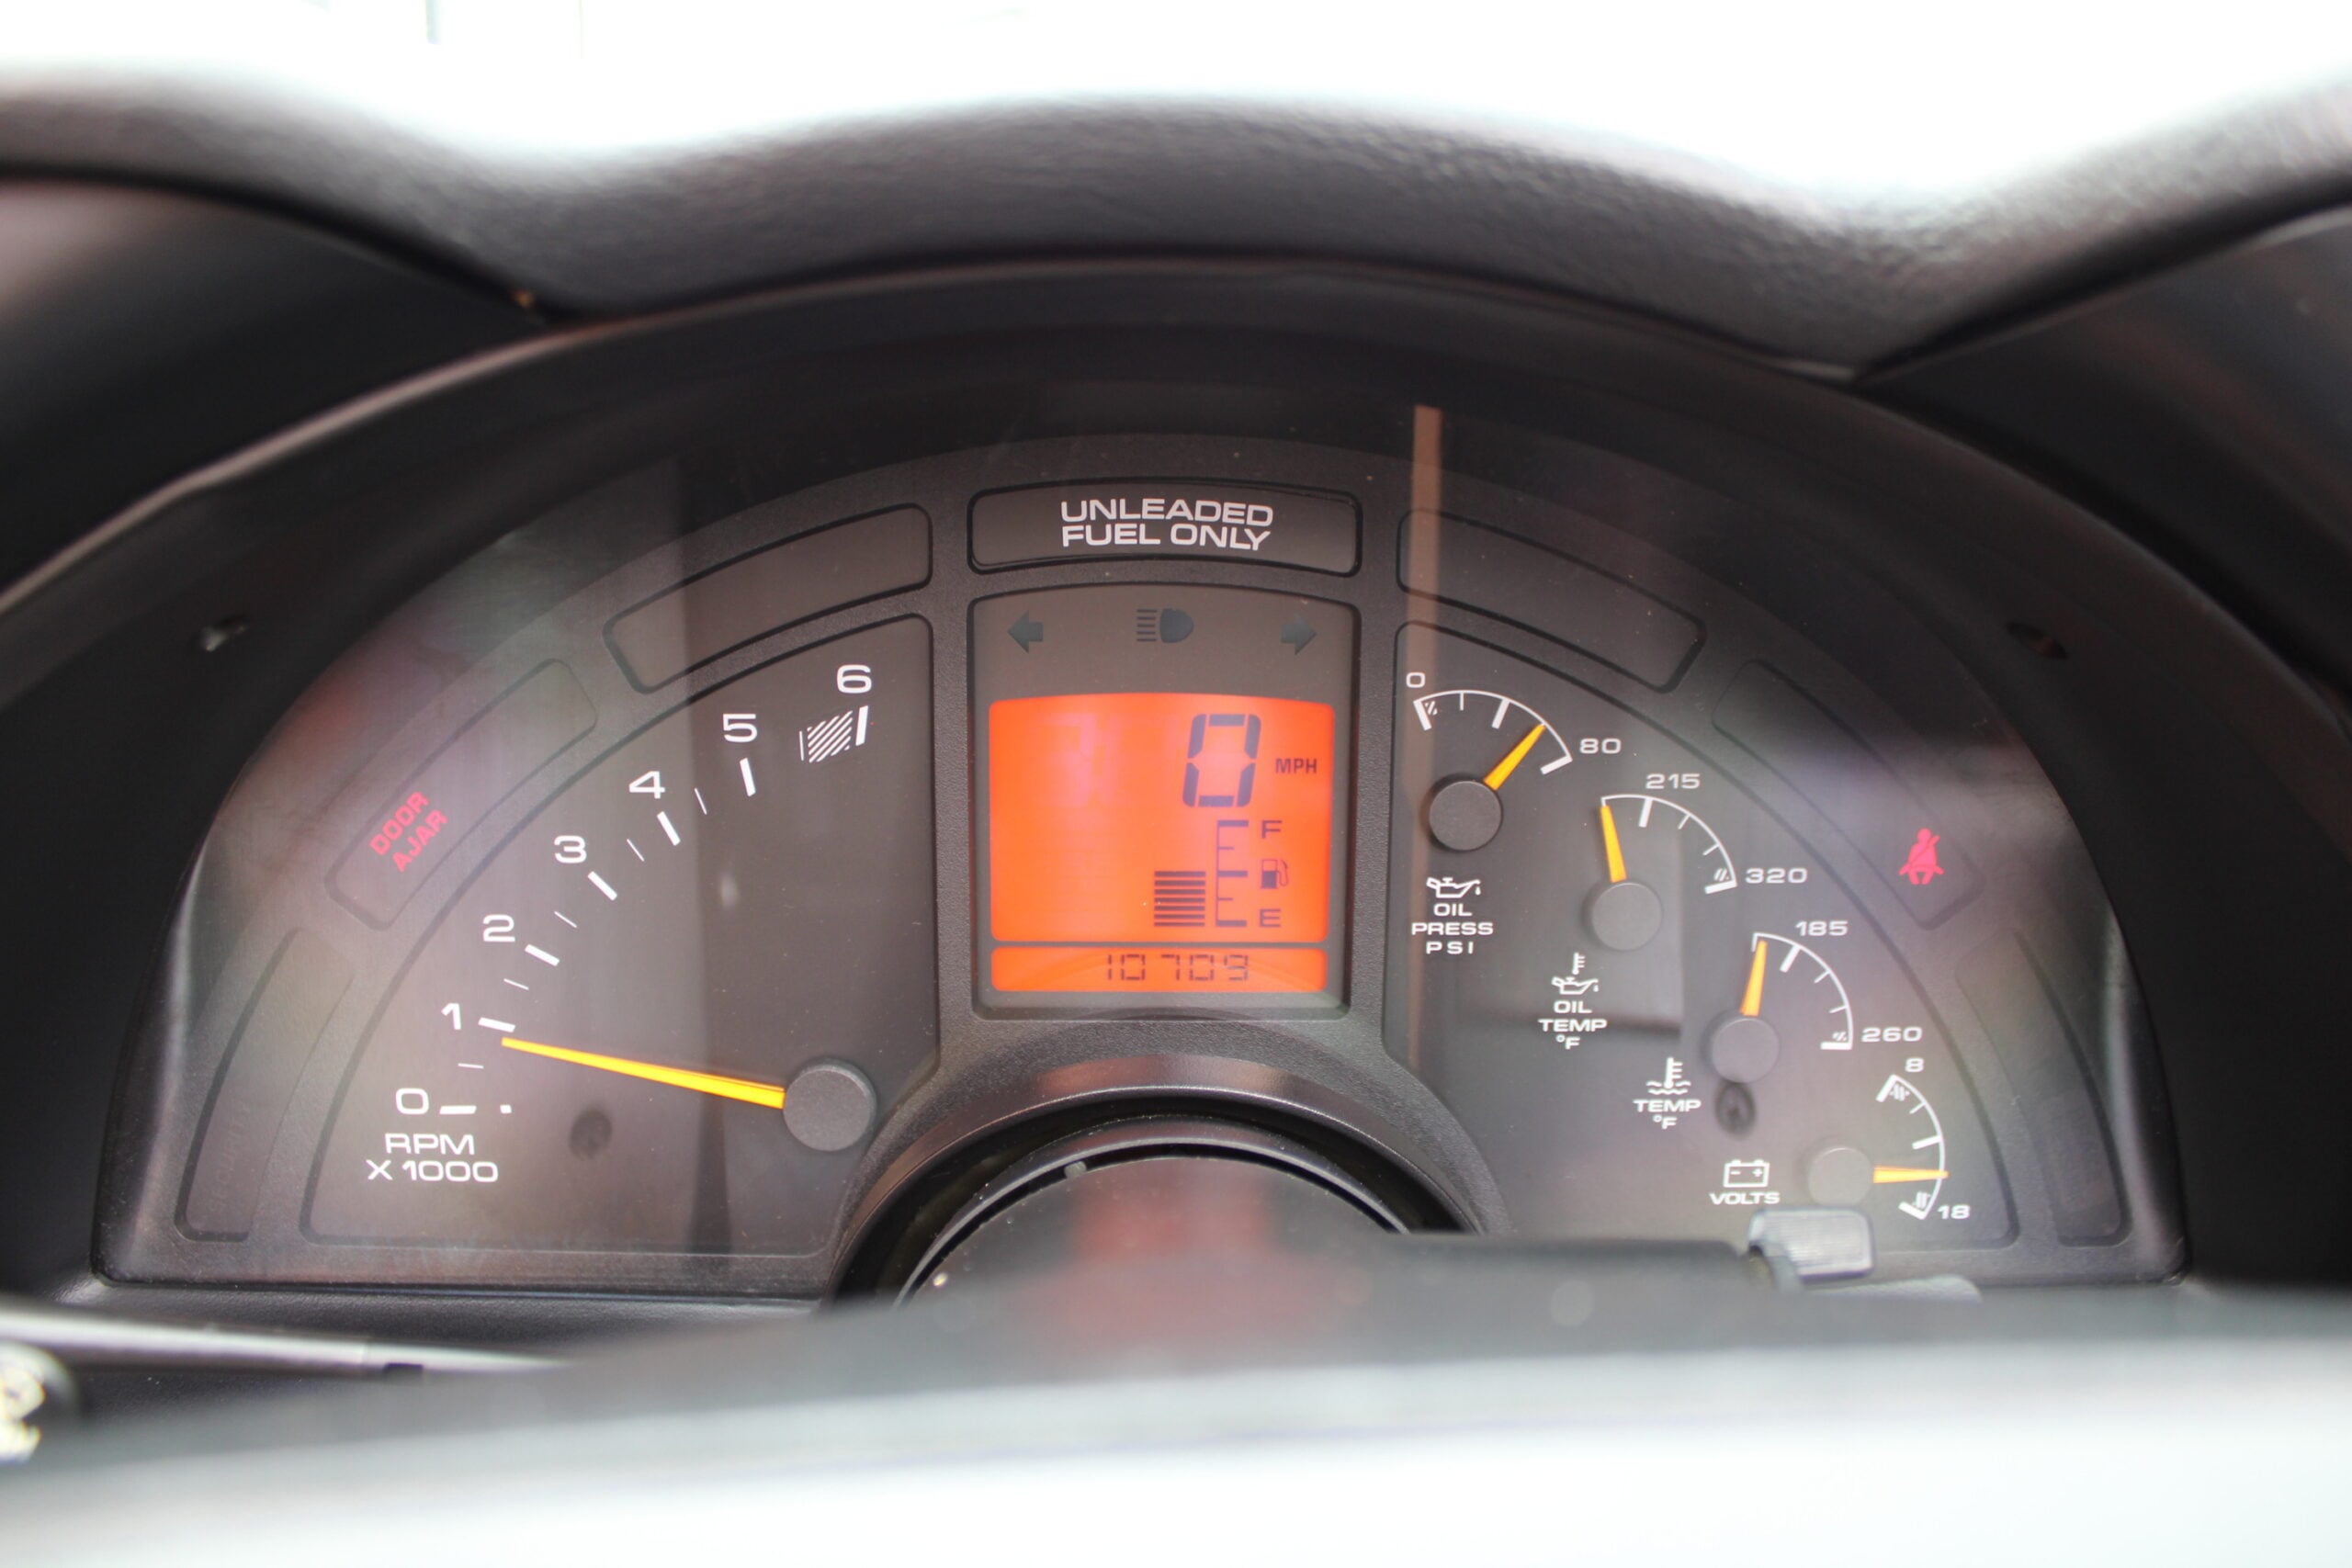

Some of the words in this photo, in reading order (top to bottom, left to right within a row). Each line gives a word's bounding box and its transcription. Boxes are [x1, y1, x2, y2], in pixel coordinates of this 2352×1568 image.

[1061, 498, 1273, 528] UNLEADED
[1062, 523, 1160, 547] FUEL
[1170, 523, 1272, 551] ONLY
[837, 665, 872, 694] 6
[1406, 672, 1427, 689] 0
[722, 714, 757, 742] 5
[1580, 738, 1622, 755] 80
[1182, 714, 1261, 807] 0
[1275, 758, 1317, 774] MPH
[629, 771, 664, 798] 4
[1645, 773, 1701, 790] 215
[369, 791, 429, 856] DOOR
[1261, 820, 1283, 840] F
[391, 808, 447, 872] AJAR
[554, 836, 586, 863] 3
[1746, 868, 1807, 884] 320
[1259, 908, 1282, 928] E
[1434, 903, 1472, 917] OIL
[482, 915, 514, 942] 2
[1411, 922, 1494, 936] PRESS
[1796, 921, 1849, 937] 185
[1107, 953, 1249, 981] 10709
[442, 1003, 461, 1029] 1
[1553, 1000, 1592, 1014] OIL
[1539, 1019, 1607, 1033] TEMP
[1861, 1027, 1923, 1043] 260
[1905, 1058, 1924, 1073] 8
[396, 1089, 429, 1114] 0
[1634, 1099, 1702, 1113] TEMP
[385, 1134, 474, 1155] RPM
[367, 1160, 392, 1179] X
[402, 1161, 498, 1182] 1000
[1709, 1192, 1781, 1206] VOLTS
[1938, 1205, 1970, 1220] 18
